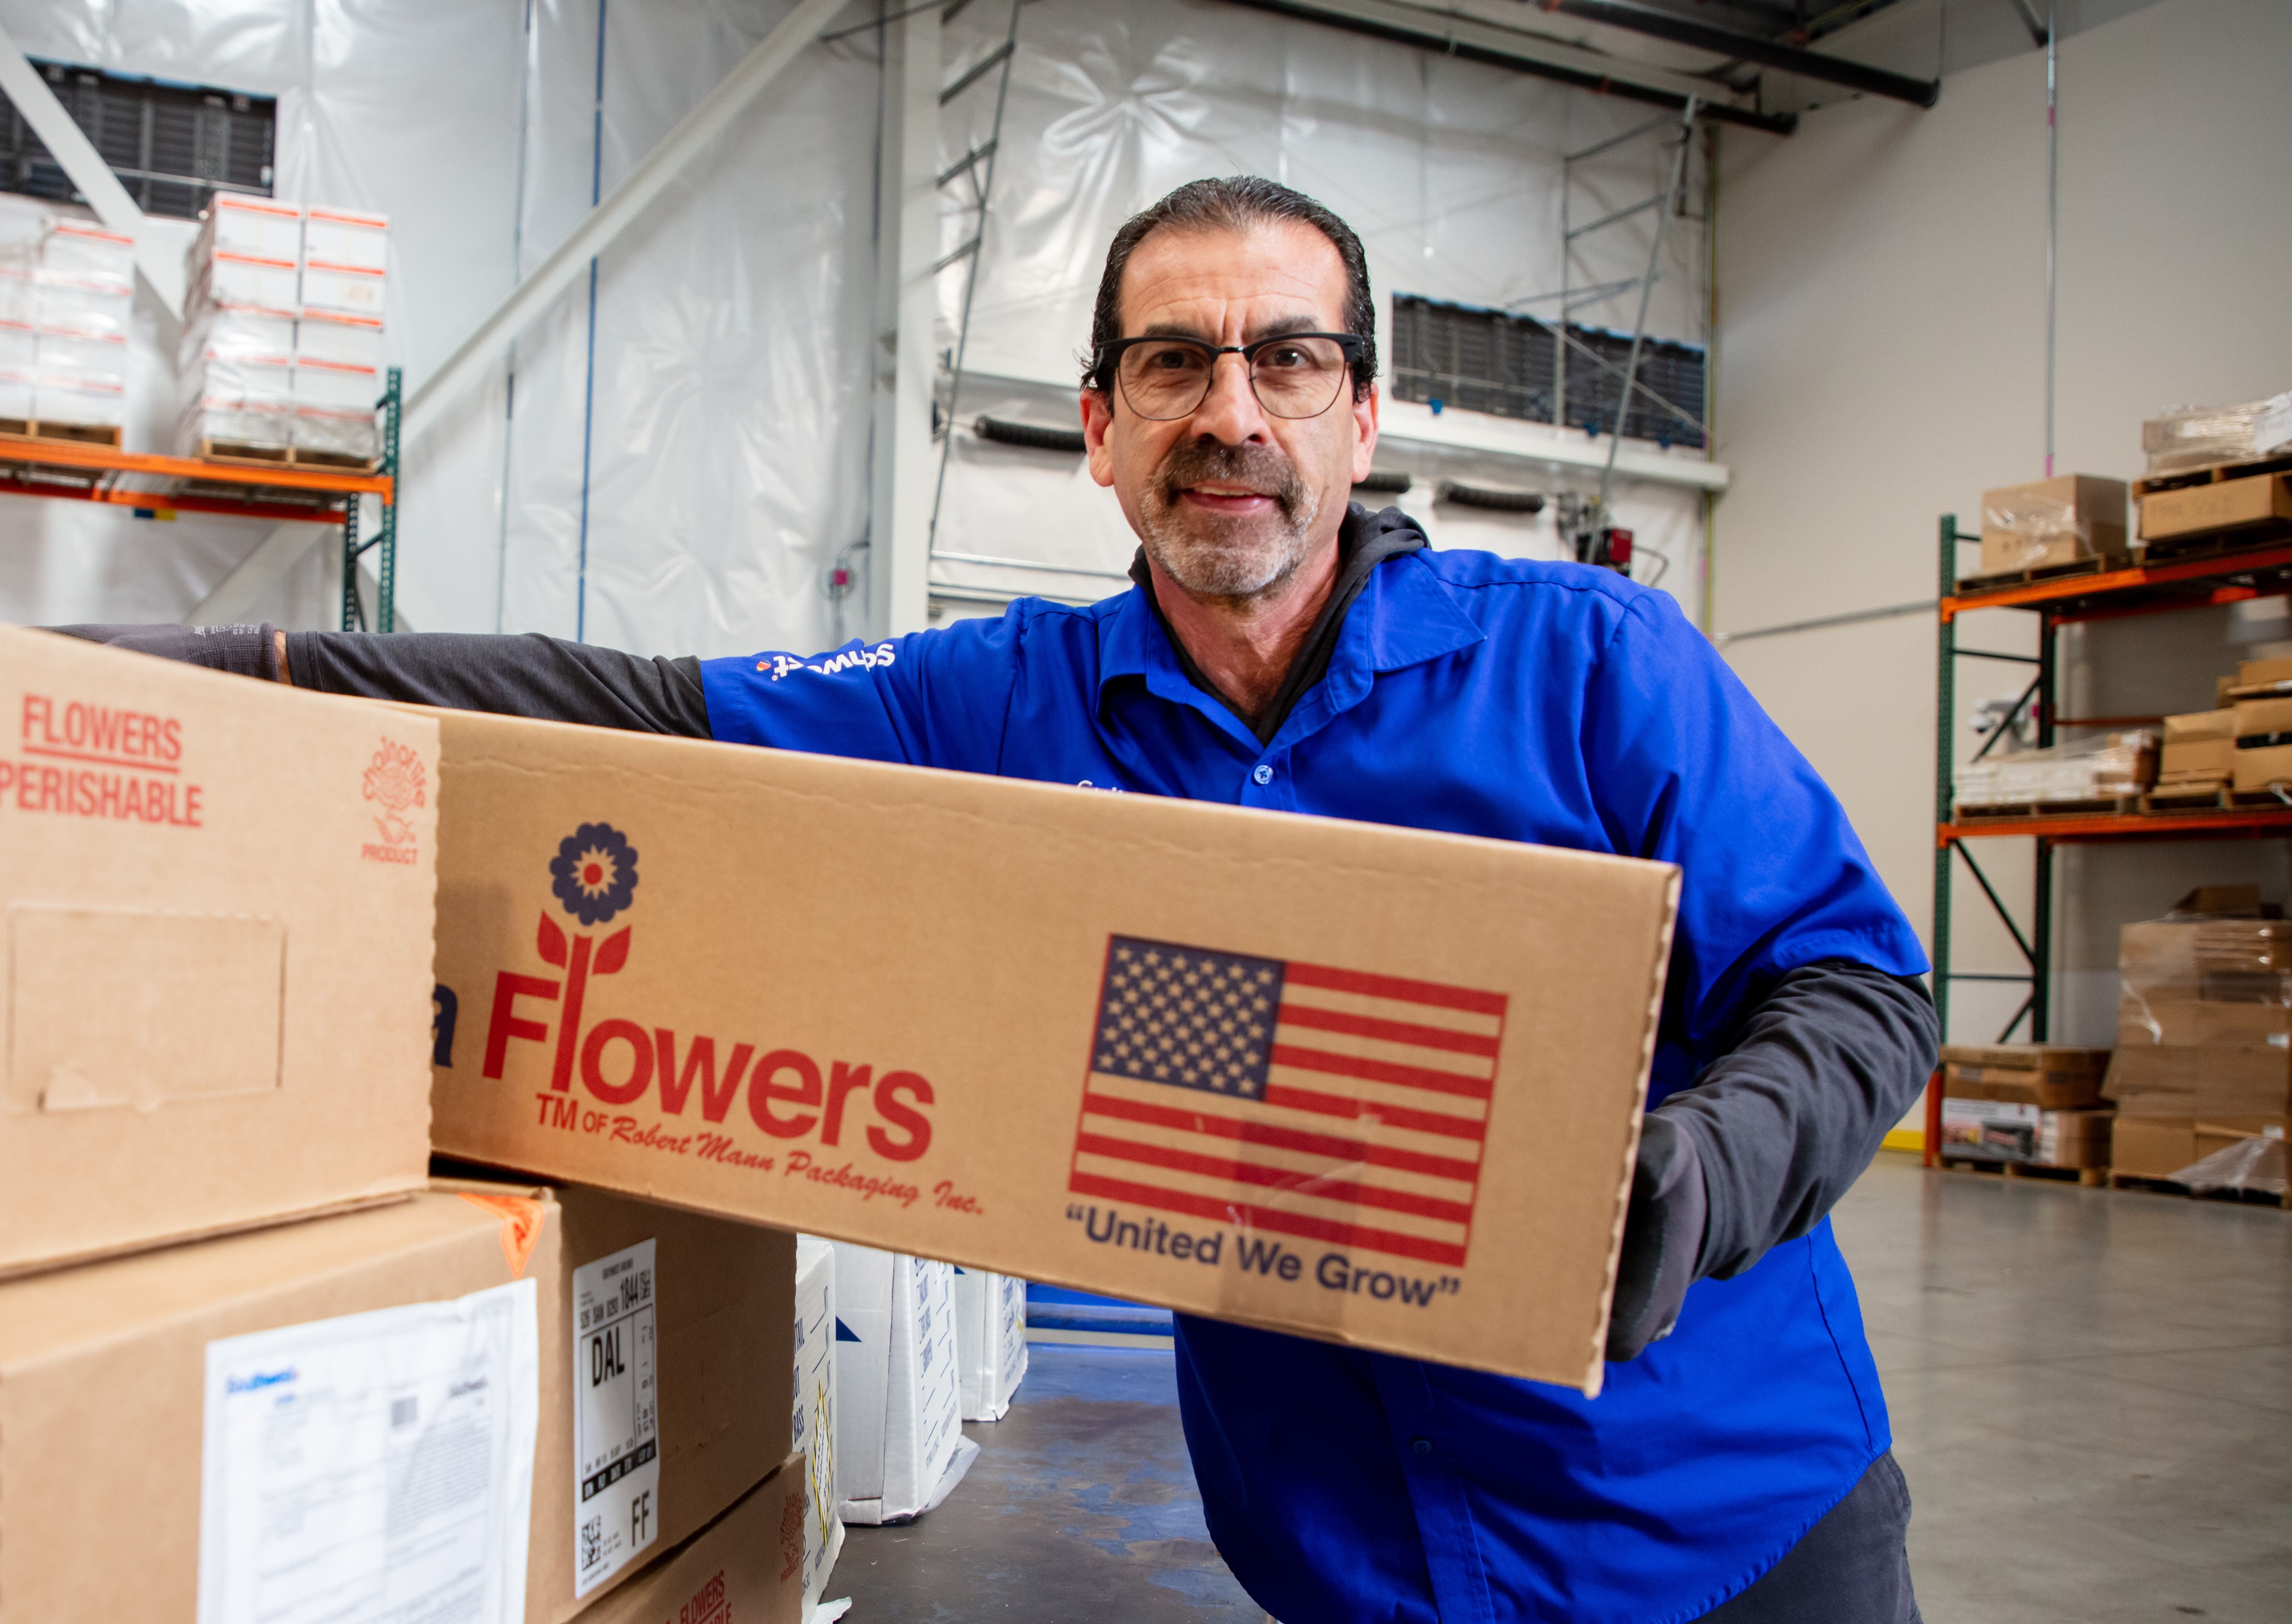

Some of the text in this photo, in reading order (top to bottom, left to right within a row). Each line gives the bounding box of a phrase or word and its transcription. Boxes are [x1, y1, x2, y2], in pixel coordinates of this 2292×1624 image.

[22, 693, 182, 762] FLOWERS
[0, 760, 203, 828] PERISHABLE
[482, 933, 935, 1163] Flowers
[535, 1092, 985, 1216] TM OF Robert Mann Packaging Inc.
[1237, 1234, 1302, 1282] We
[592, 1325, 625, 1388] DAL
[793, 1404, 804, 1445] BASS
[632, 1489, 650, 1547] FF
[680, 1569, 725, 1624] FLOWERS
